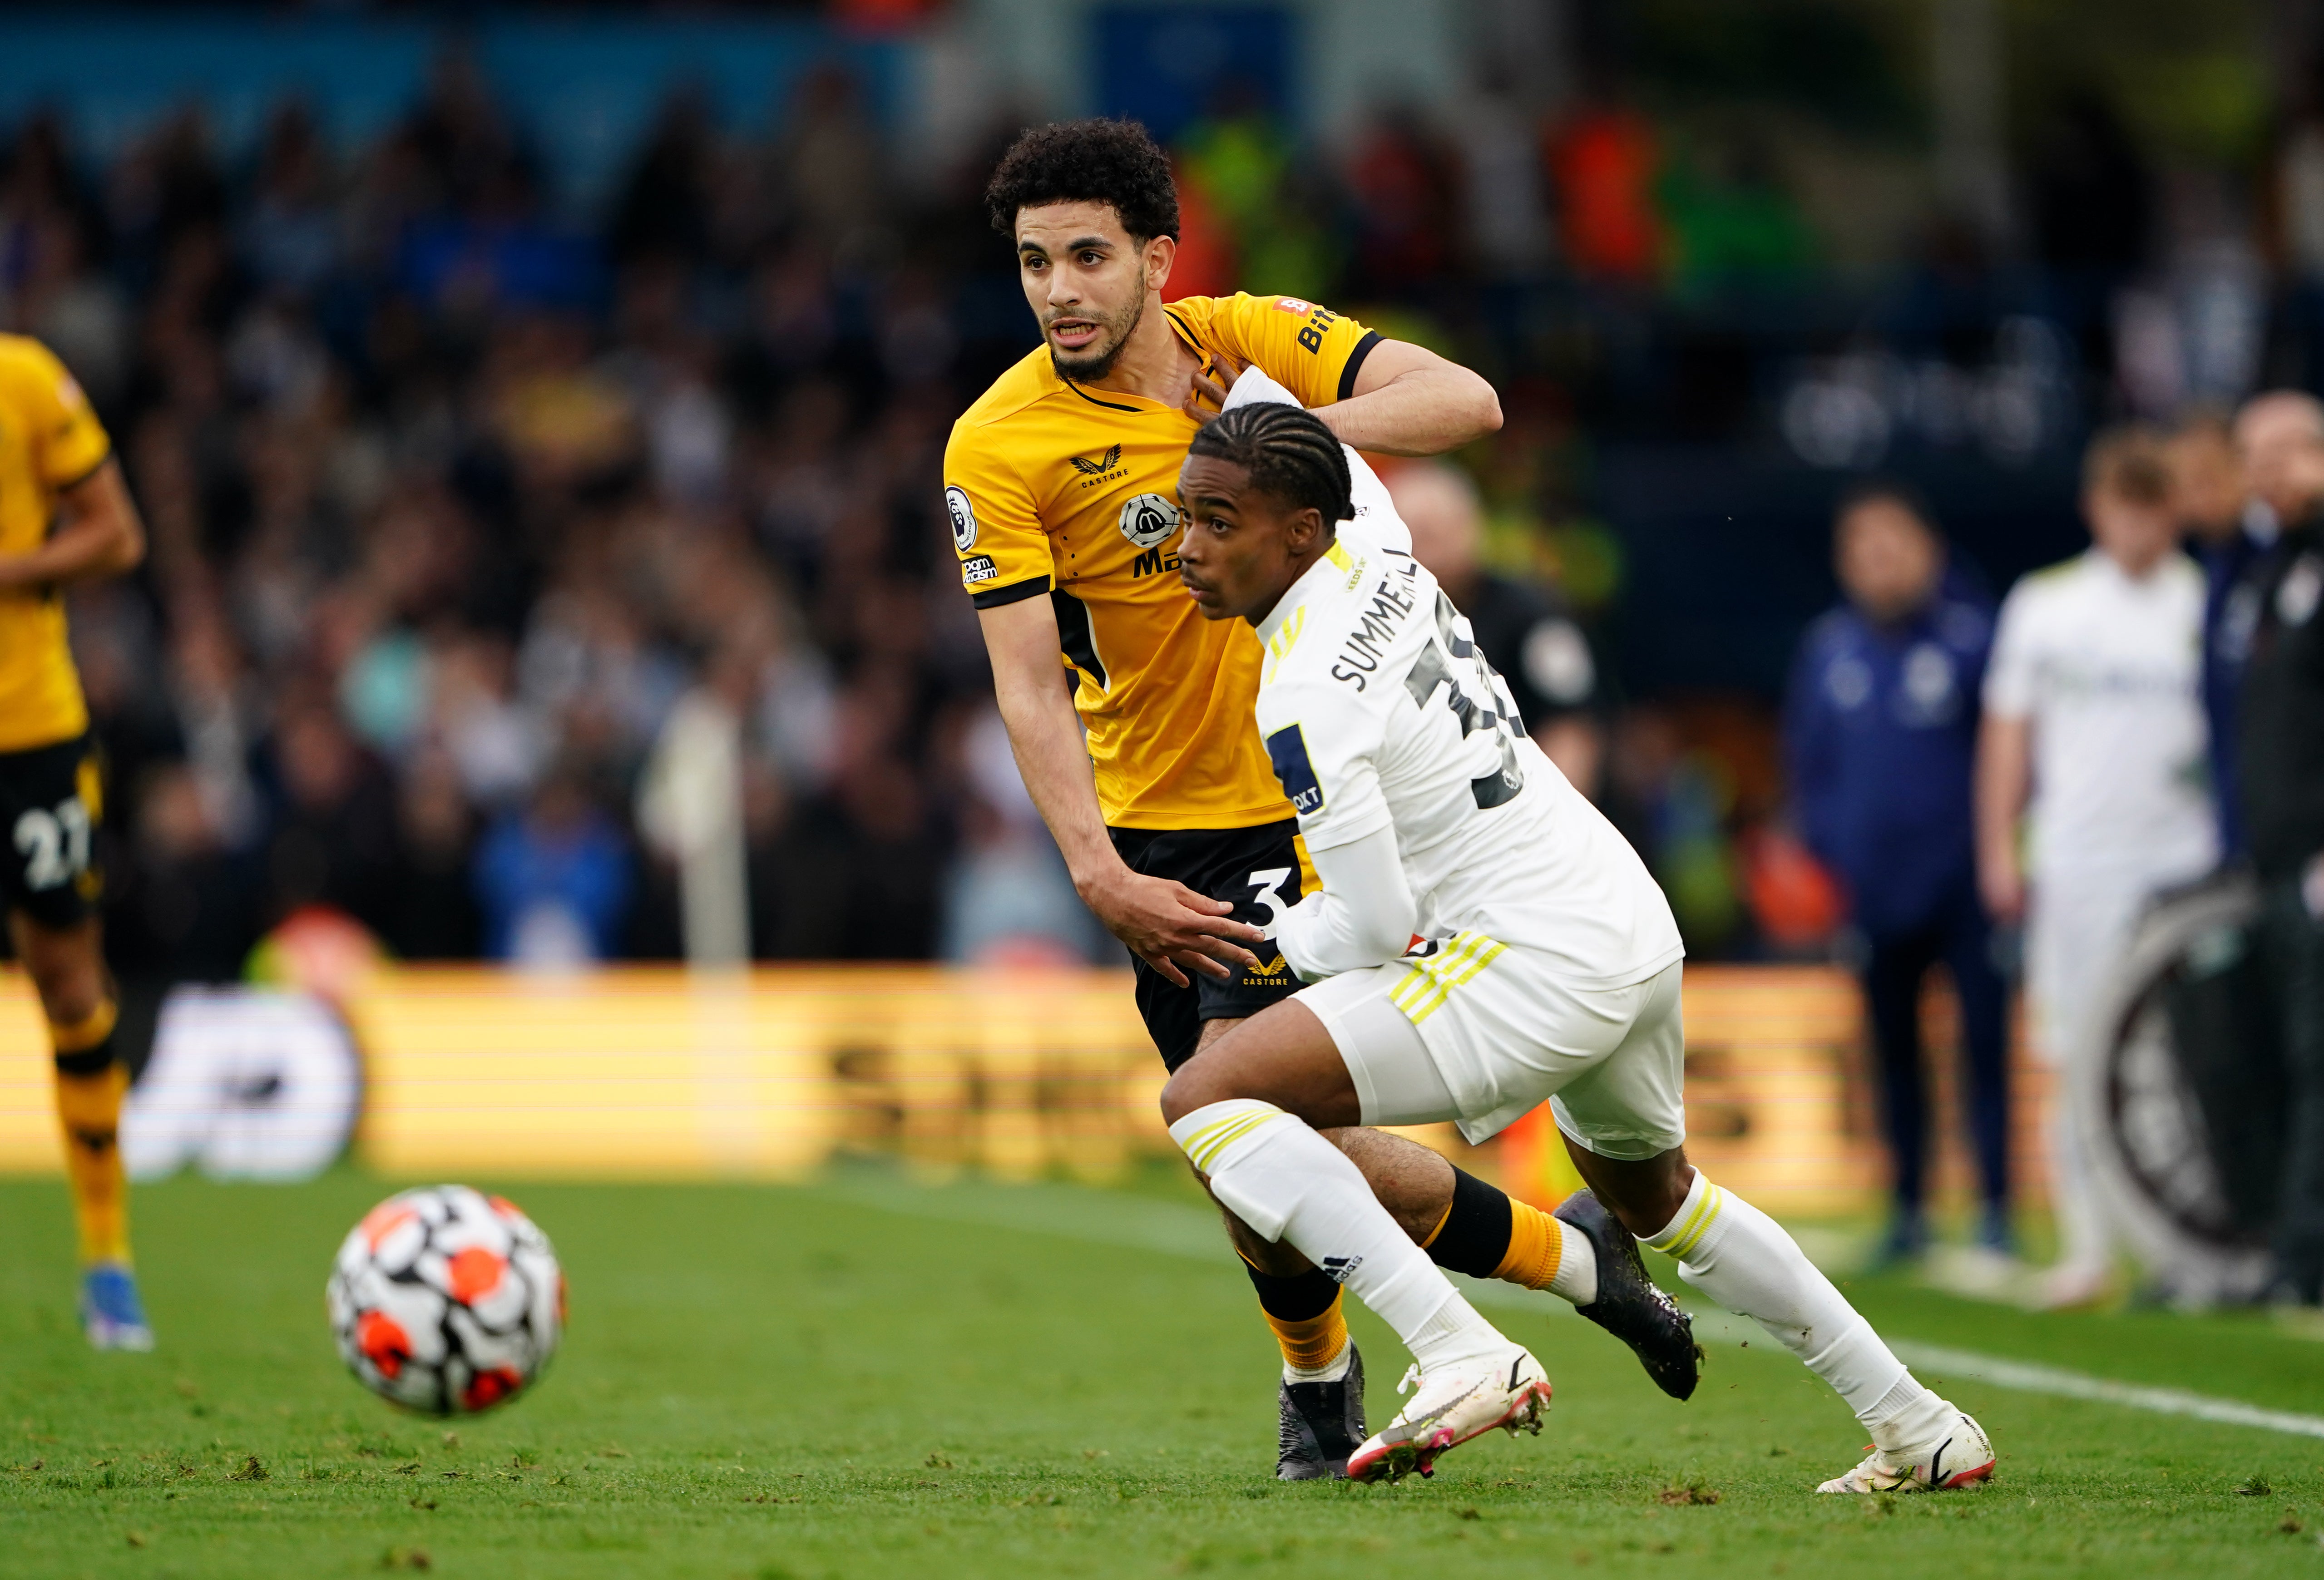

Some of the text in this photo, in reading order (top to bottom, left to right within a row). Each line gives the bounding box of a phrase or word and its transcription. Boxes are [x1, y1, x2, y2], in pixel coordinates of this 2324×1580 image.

[1081, 469, 1129, 489] CASTORE
[963, 558, 990, 572] oom
[1245, 867, 1292, 941] 3
[1243, 978, 1288, 986] CASTORE
